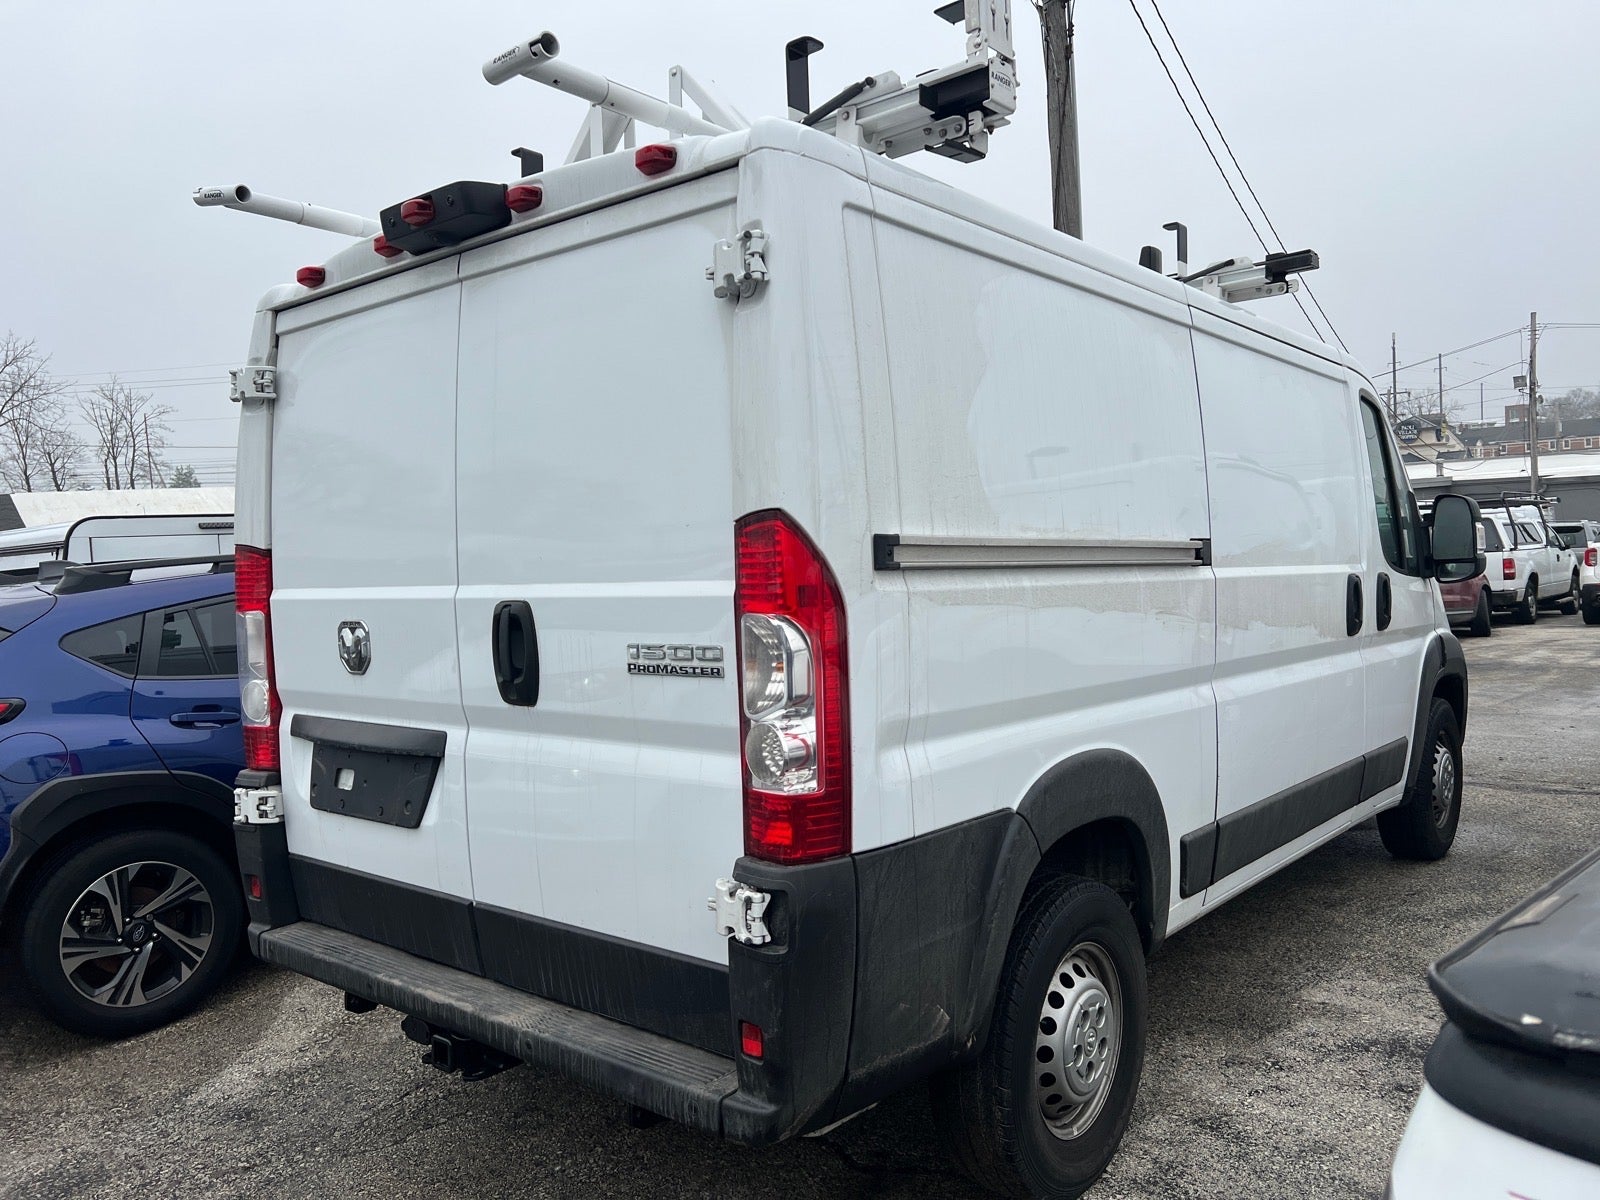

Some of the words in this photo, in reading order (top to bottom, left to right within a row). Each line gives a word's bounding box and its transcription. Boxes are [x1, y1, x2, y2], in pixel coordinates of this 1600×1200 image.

[493, 46, 518, 64] RANGER
[991, 71, 1011, 87] RANGER
[627, 643, 724, 662] 1500
